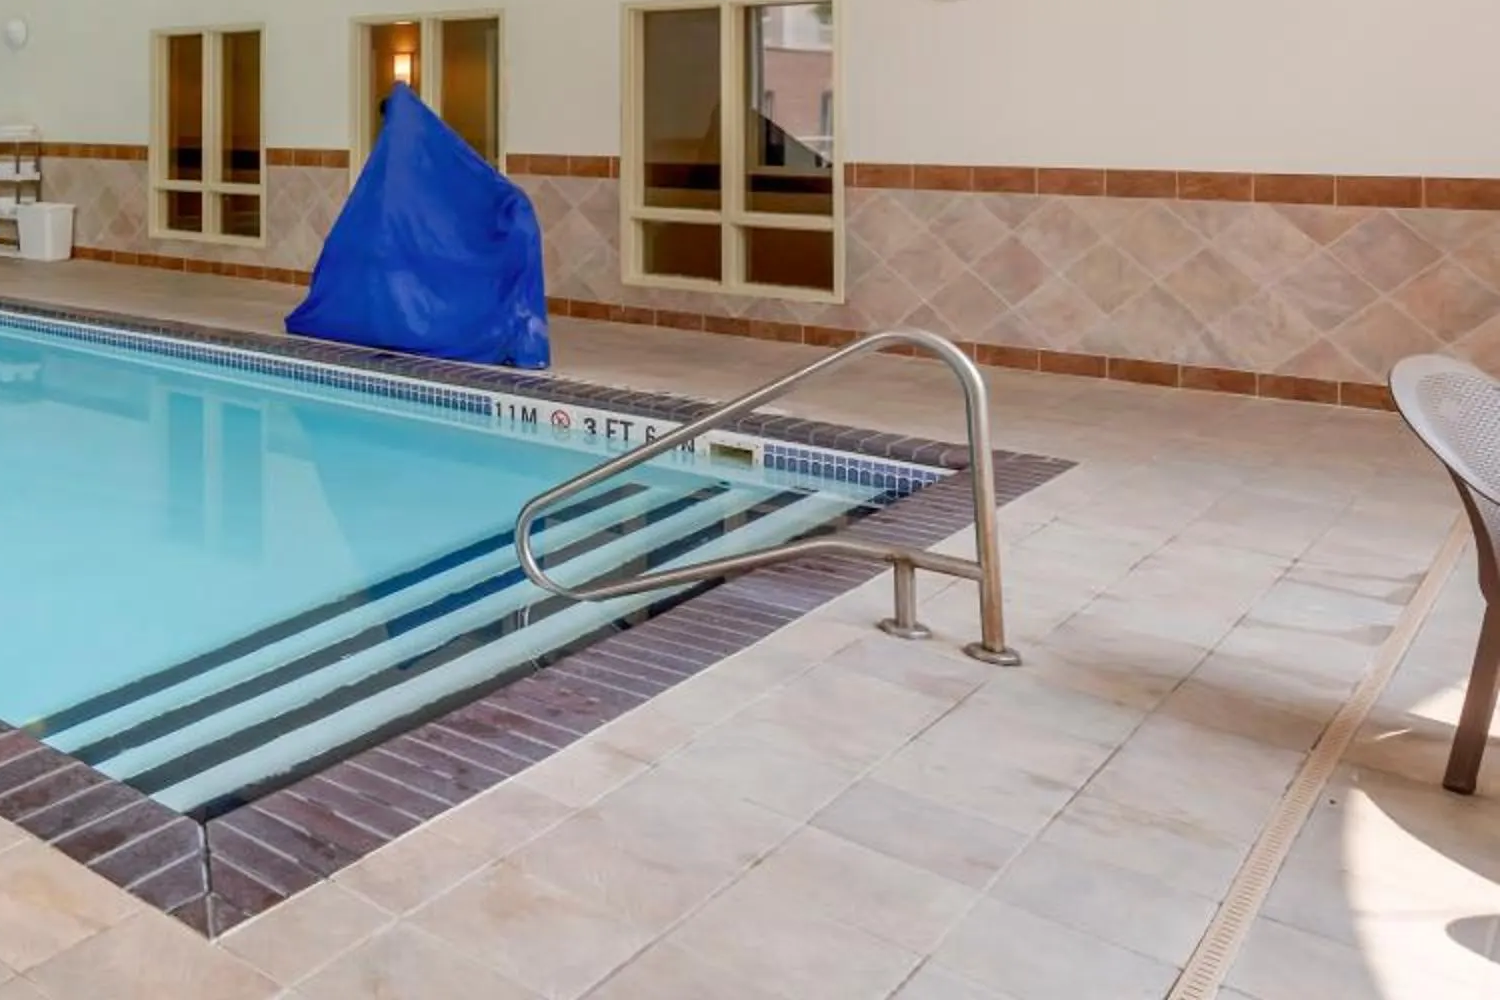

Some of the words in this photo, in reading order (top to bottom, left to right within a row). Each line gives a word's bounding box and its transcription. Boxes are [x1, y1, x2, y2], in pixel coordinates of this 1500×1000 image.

[583, 418, 596, 435] 3
[606, 418, 634, 441] FT
[645, 425, 657, 446] 6
